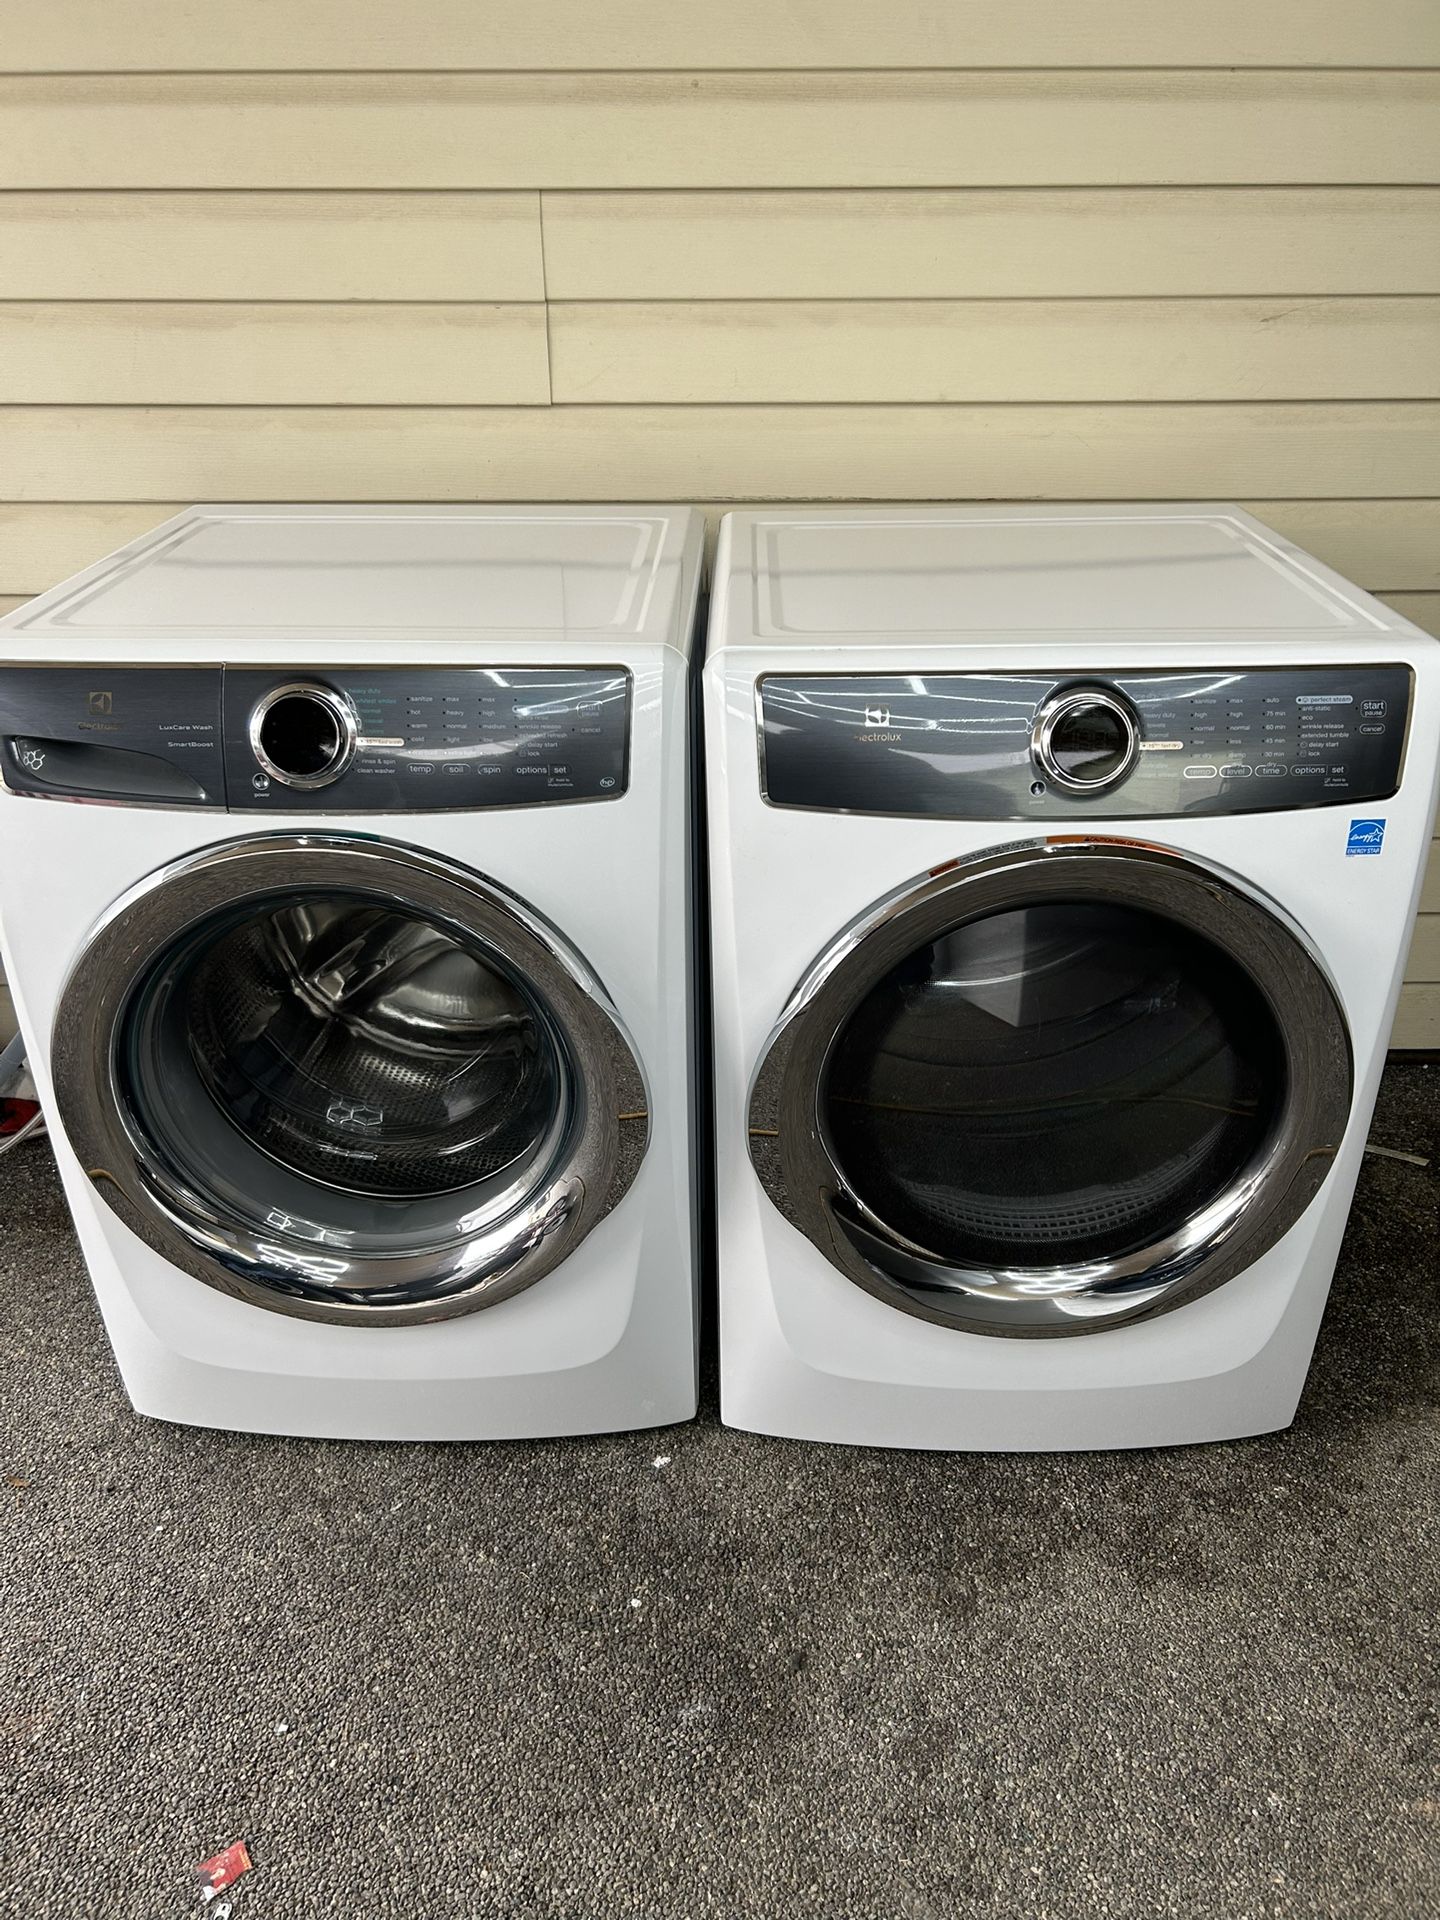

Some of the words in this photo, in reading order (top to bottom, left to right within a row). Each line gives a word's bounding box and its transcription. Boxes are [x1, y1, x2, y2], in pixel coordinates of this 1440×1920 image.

[1363, 701, 1384, 710] start
[410, 765, 432, 774] temp
[483, 766, 501, 775] spin
[516, 766, 548, 775] options
[1295, 767, 1326, 776] options
[1331, 766, 1345, 774] set
